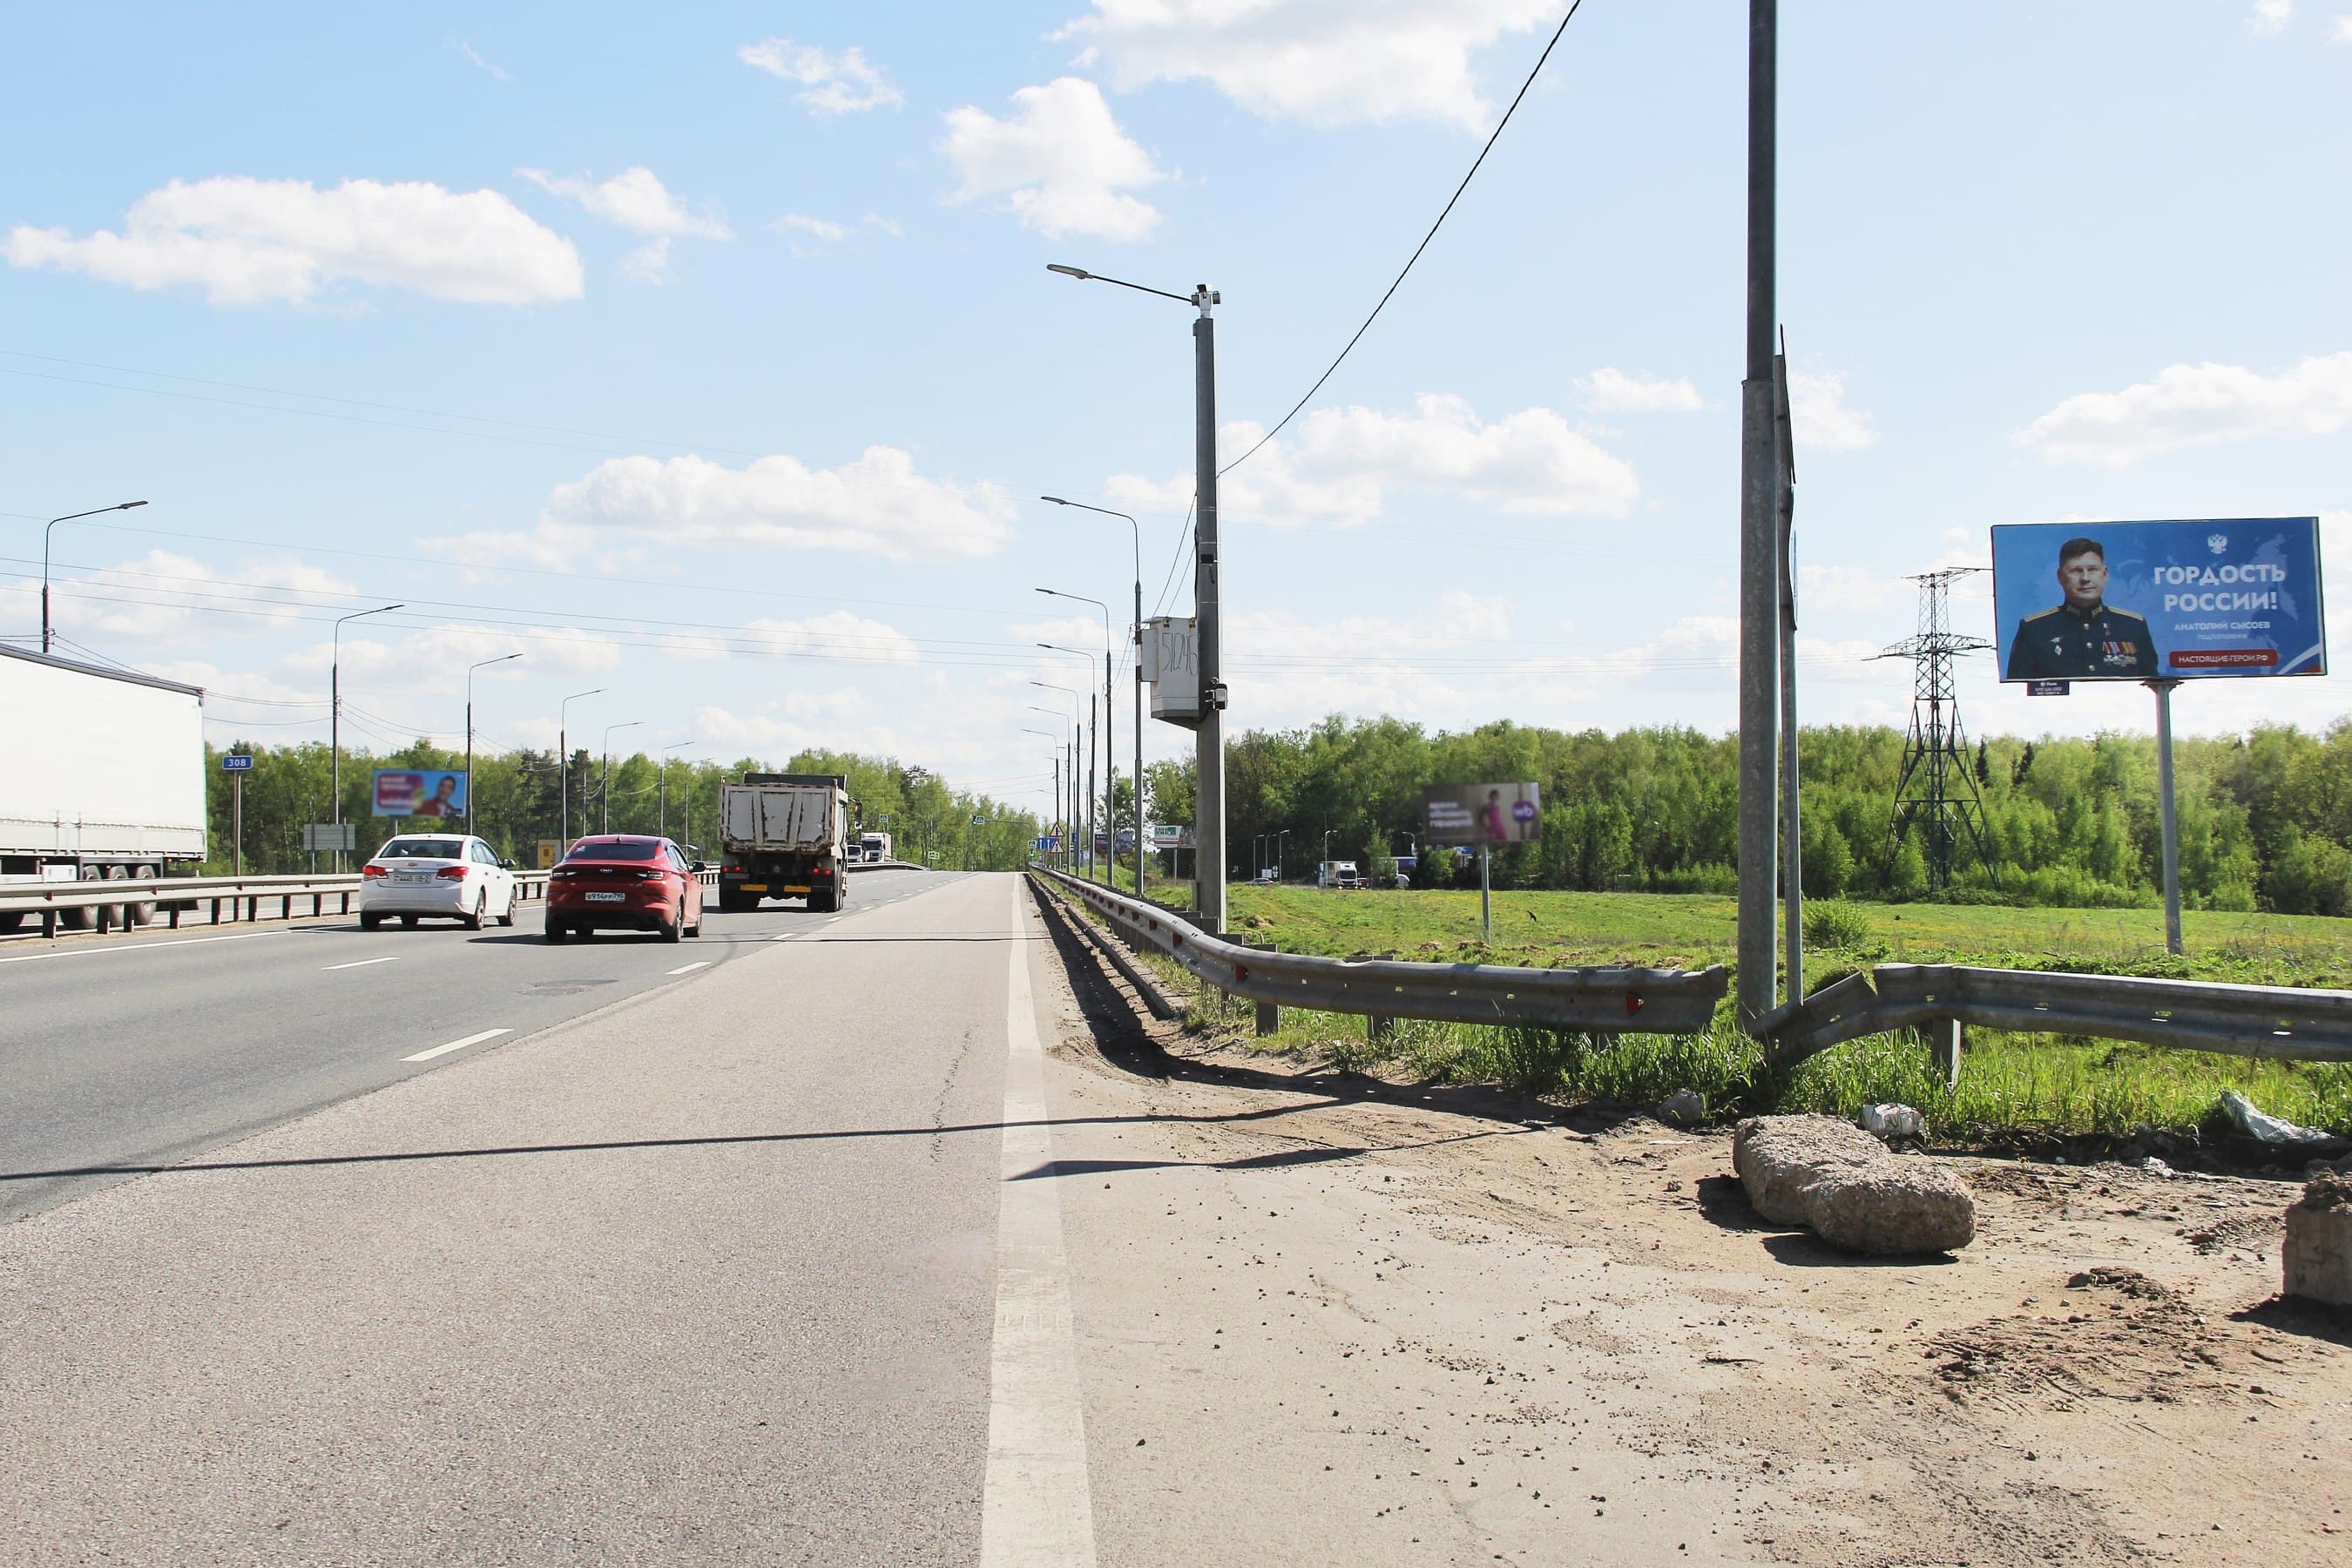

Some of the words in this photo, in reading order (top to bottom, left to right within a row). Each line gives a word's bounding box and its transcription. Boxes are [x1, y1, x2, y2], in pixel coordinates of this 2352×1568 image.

[2153, 564, 2286, 586] ГОРДОСТЬ
[2164, 591, 2278, 612] РОССИИ!
[2174, 620, 2227, 631] АНАТОЛИЙ
[2230, 621, 2270, 630] СЫСОЕВ
